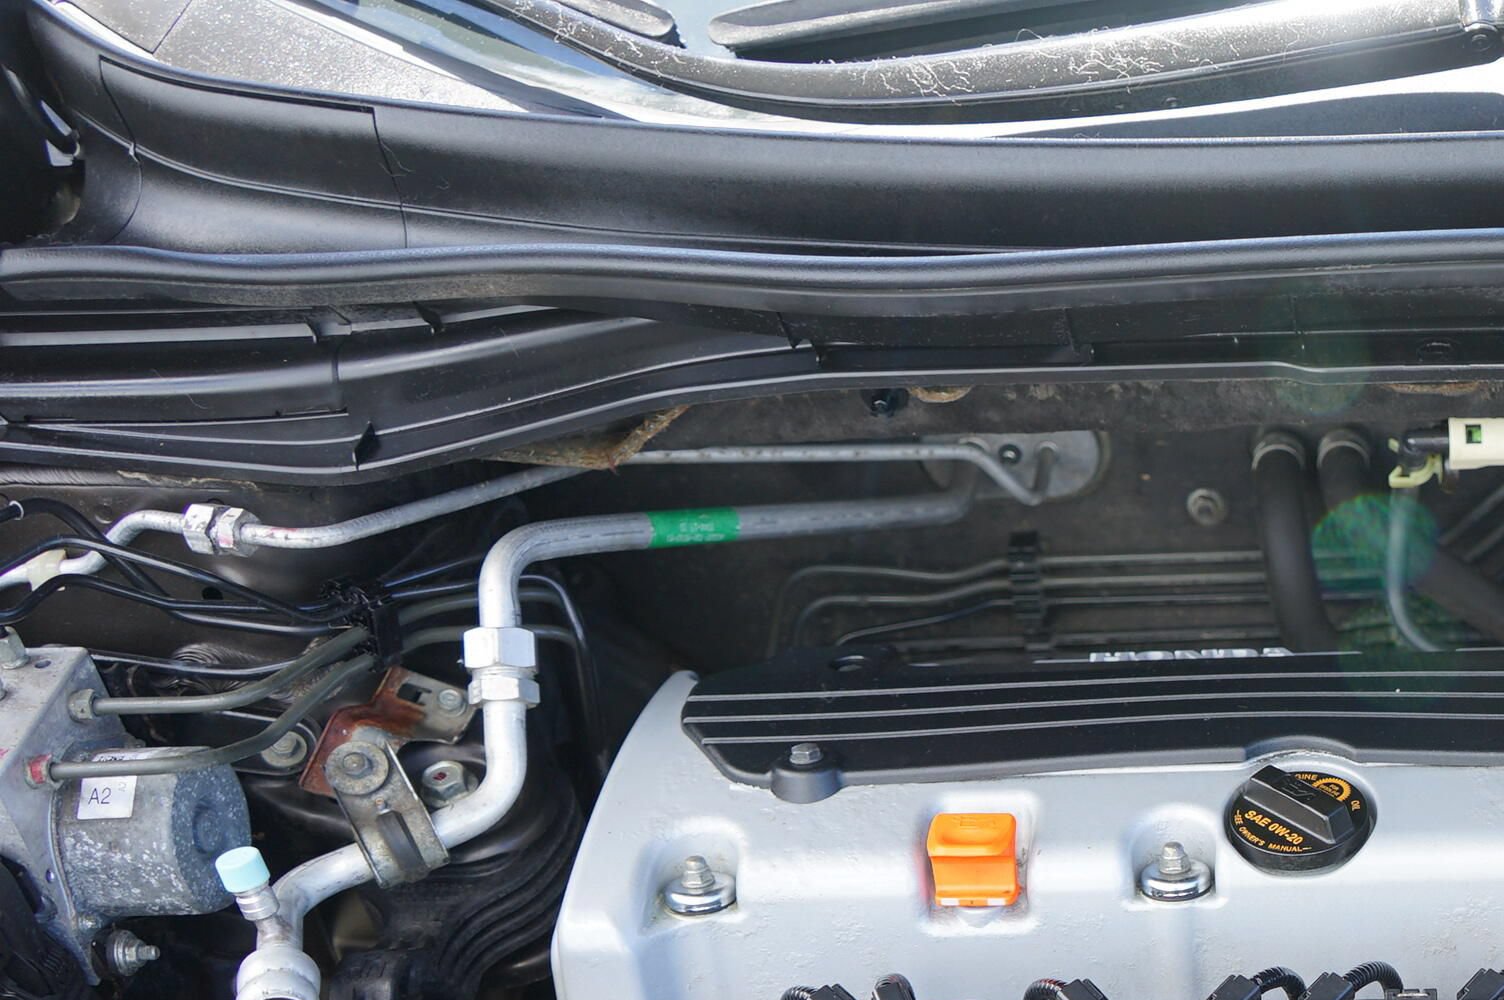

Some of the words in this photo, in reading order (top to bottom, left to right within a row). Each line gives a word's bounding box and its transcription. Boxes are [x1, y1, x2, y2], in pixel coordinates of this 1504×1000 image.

[1295, 773, 1319, 781] GINE
[88, 787, 112, 805] A2
[1350, 800, 1361, 811] OIL
[1244, 810, 1271, 827] SAE
[1268, 823, 1304, 845] 0W-20
[1268, 844, 1302, 852] MANUAL
